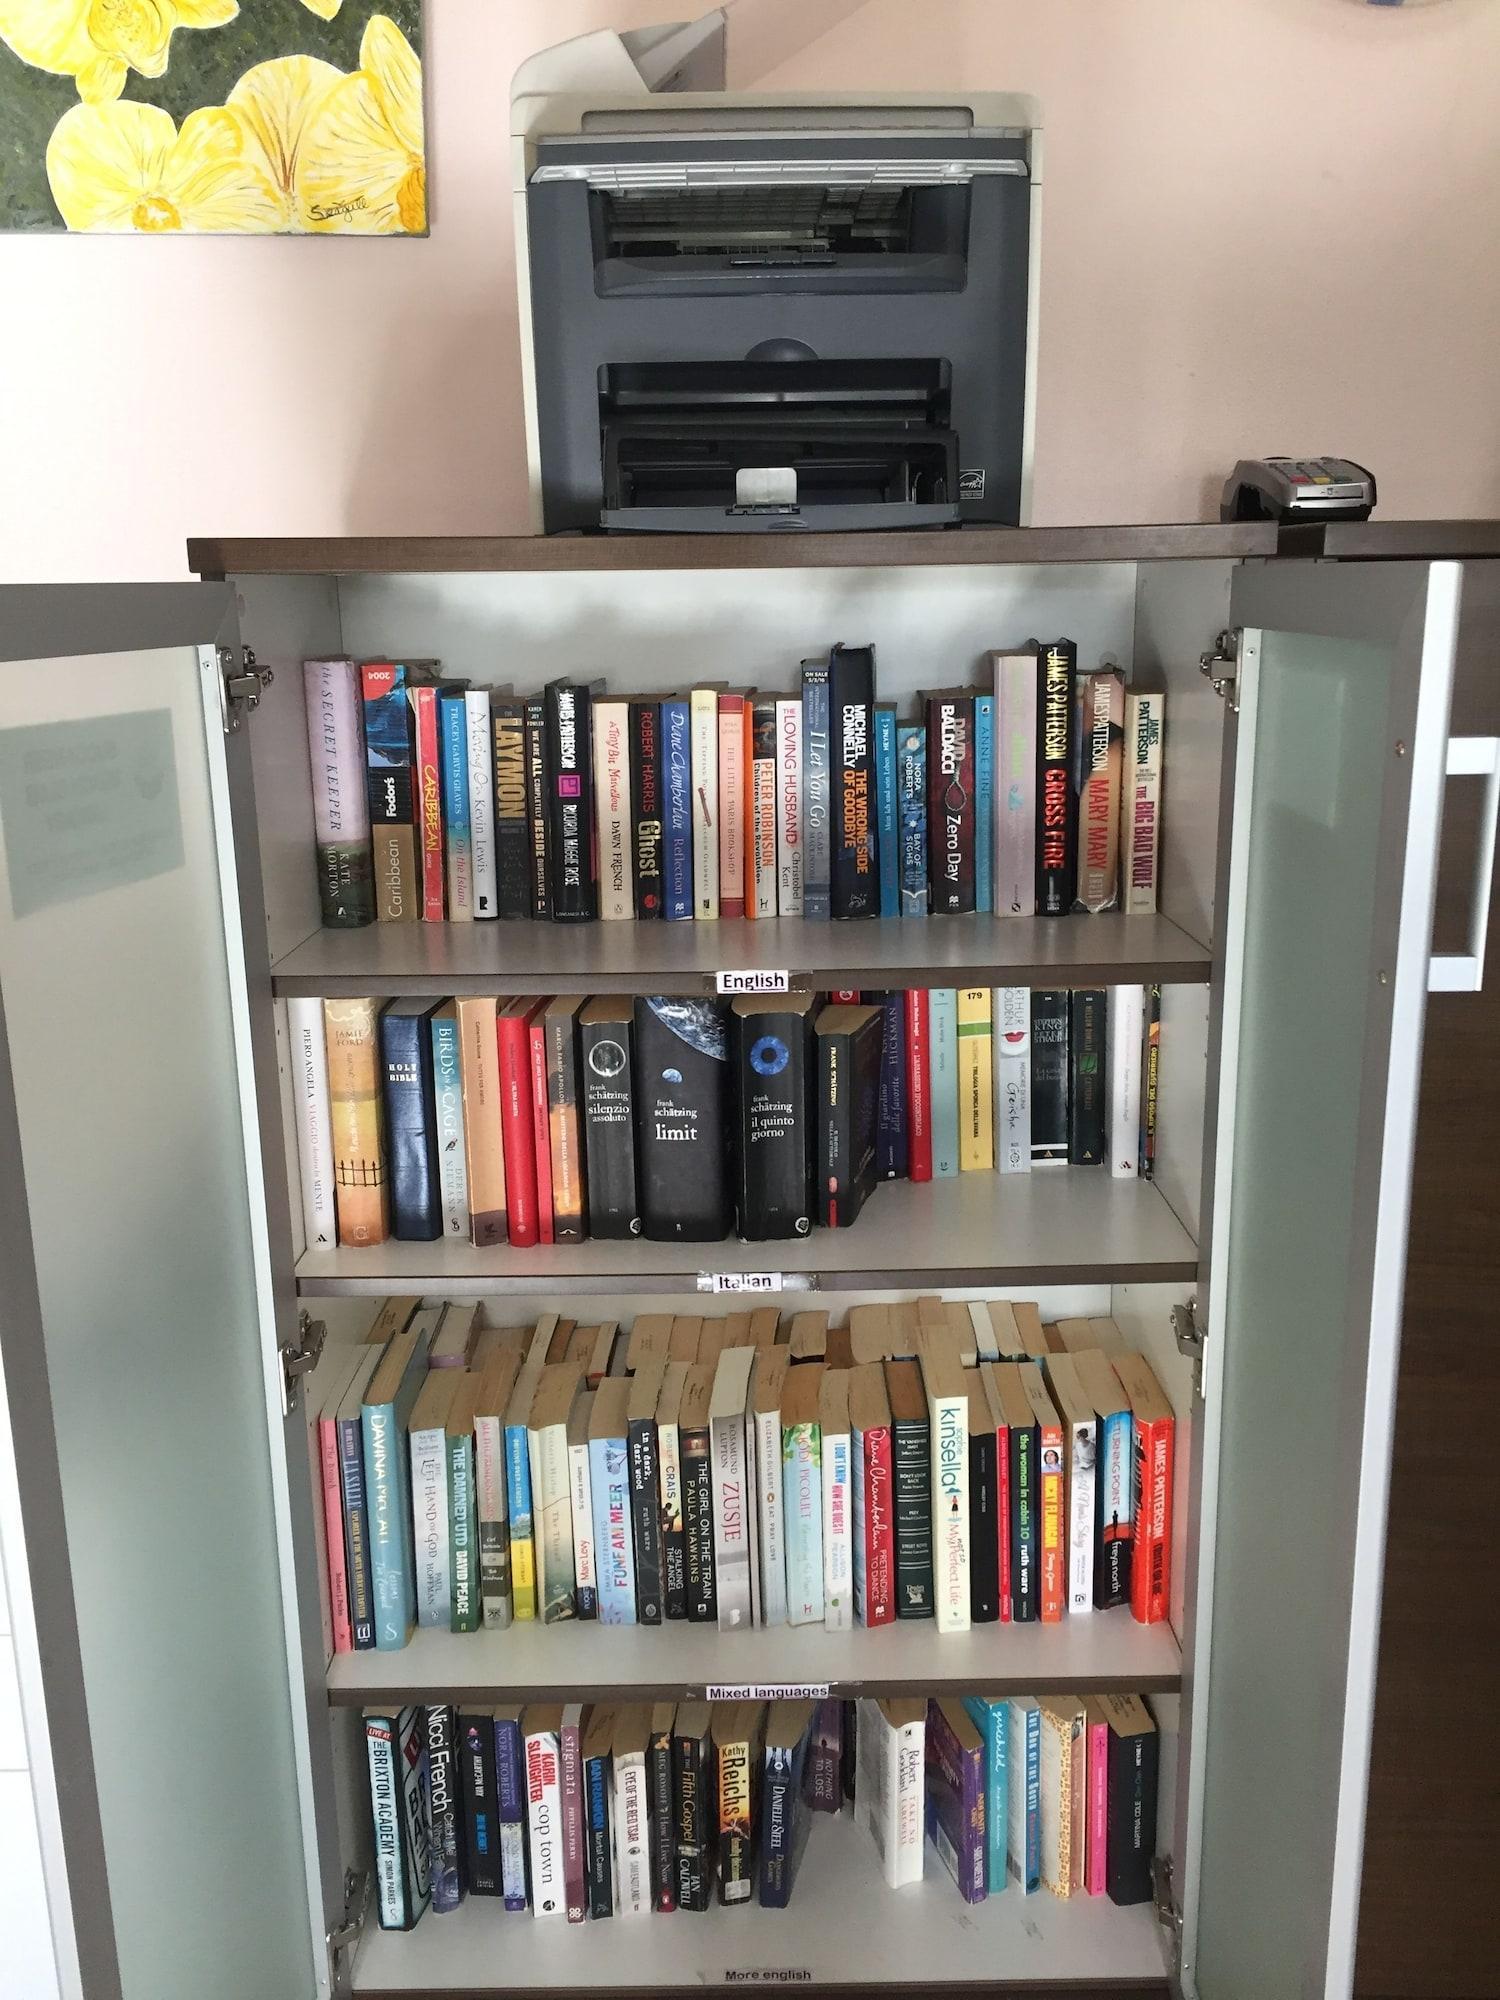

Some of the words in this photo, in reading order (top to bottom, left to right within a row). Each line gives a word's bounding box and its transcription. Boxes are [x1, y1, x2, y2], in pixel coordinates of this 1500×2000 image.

[322, 667, 331, 686] the
[1047, 651, 1068, 691] JAMES
[322, 690, 337, 758] SECRET
[641, 712, 653, 760] ROBERT
[670, 711, 684, 755] Diane
[843, 705, 854, 767] CONNELLY
[854, 705, 865, 759] MICHAEL
[941, 705, 954, 774] BALDACCI
[953, 718, 966, 761] DAVID
[1046, 694, 1066, 760] PATTERSON
[1138, 701, 1150, 764] PATTERSON
[1149, 719, 1158, 745] JAMES
[785, 716, 796, 769] LOVING
[811, 743, 825, 765] Let
[495, 717, 525, 817] LAYMON
[761, 762, 773, 799] PETER
[844, 771, 854, 786] OF
[856, 769, 865, 794] THE
[326, 764, 341, 830] KEEPER
[642, 764, 654, 812] HARRIS
[671, 756, 687, 831] Chamberlain
[810, 773, 825, 798] You
[1045, 769, 1066, 826] CROSS
[1088, 780, 1109, 821] MARY
[1136, 786, 1146, 799] THE
[423, 765, 440, 851] CARIBBEAN
[475, 800, 485, 833] Kevin
[786, 775, 797, 844] HUSBAND
[809, 805, 825, 827] Go
[844, 788, 856, 848] GOODBYE
[857, 797, 867, 843] WRONG
[1135, 801, 1155, 823] BIG
[612, 821, 621, 848] DAWN
[762, 804, 773, 866] ROBINSON
[947, 815, 961, 849] Zero
[1087, 827, 1109, 869] MARY
[1133, 826, 1152, 853] BAD
[477, 840, 487, 873] Lewis
[638, 820, 661, 878] Ghost
[857, 846, 867, 873] SIDE
[914, 854, 921, 866] OF
[1044, 831, 1065, 869] FIRE
[327, 845, 339, 897] MORTON
[340, 853, 351, 885] KATE
[386, 838, 403, 918] Caribbean
[613, 853, 622, 891] FRENCH
[673, 839, 684, 894] Reflection
[782, 867, 791, 887] Kent
[791, 852, 801, 900] Christobel
[946, 853, 960, 881] Day
[1133, 856, 1152, 888] WOLF
[723, 972, 784, 990] English
[303, 1029, 313, 1058] PIERO
[439, 1028, 454, 1074] BIRDS
[306, 1060, 315, 1098] ANGELA
[588, 1104, 629, 1114] silenzio
[589, 1091, 628, 1101] schätzing
[751, 1103, 792, 1113] schätzing
[443, 1092, 456, 1136] CAGE
[593, 1114, 626, 1122] assoluto
[654, 1108, 697, 1118] schätzing
[751, 1118, 758, 1127] il
[760, 1118, 795, 1129] quinto
[656, 1124, 697, 1140] limit
[751, 1130, 784, 1141] giorno
[720, 1274, 771, 1288] Italian
[869, 1430, 886, 1466] Diane
[941, 1408, 960, 1486] kinsella
[1020, 1434, 1028, 1450] the
[1154, 1440, 1165, 1474] JAMES
[453, 1447, 464, 1471] THE
[699, 1461, 707, 1484] THE
[454, 1472, 466, 1521] DAMNED
[666, 1466, 676, 1498] CRAIS
[1021, 1489, 1028, 1497] in
[609, 1483, 624, 1523] MEER
[687, 1480, 696, 1520] PAULA
[700, 1488, 708, 1514] GIRL
[722, 1481, 741, 1543] ZUSJE
[870, 1468, 887, 1550] Chamberlain
[1021, 1500, 1029, 1525] cabin
[1154, 1478, 1165, 1539] PATTERSON
[456, 1523, 467, 1545] UTD
[611, 1528, 625, 1549] AM
[700, 1519, 710, 1535] ON
[1021, 1527, 1029, 1539] 10
[456, 1551, 467, 1580] DAVID
[690, 1528, 699, 1583] HAWKINS
[701, 1540, 710, 1561] THE
[872, 1556, 879, 1567] TO
[612, 1552, 627, 1587] FÜNF
[668, 1566, 676, 1592] ANGEL
[703, 1566, 711, 1599] TRAIN
[879, 1550, 887, 1603] PRETENDING
[457, 1583, 468, 1614] PEACE
[710, 1688, 750, 1698] Mixed
[755, 1688, 827, 1700] languages
[427, 1705, 448, 1749] Nicci
[373, 1741, 387, 1749] THE
[723, 1746, 746, 1757] Kathy
[373, 1750, 391, 1799] BRIXTON
[527, 1741, 542, 1803] SLAUGHTER
[542, 1753, 555, 1785] KARIN
[564, 1735, 576, 1794] stigmata
[625, 1772, 636, 1785] EYE
[816, 1760, 823, 1771] TO
[825, 1759, 833, 1800] NOTHING
[430, 1750, 452, 1813] French
[626, 1785, 636, 1794] OF
[682, 1771, 695, 1797] Fifth
[723, 1758, 746, 1816] Reichs
[815, 1774, 823, 1796] LOSE
[626, 1795, 637, 1809] THE
[627, 1810, 637, 1824] RED
[378, 1803, 393, 1855] ACADEMY
[535, 1805, 551, 1835] cop
[568, 1807, 576, 1837] PHYLLIS
[627, 1825, 637, 1842] TSAR
[680, 1800, 695, 1842] Gospel
[595, 1832, 603, 1854] Mortal
[384, 1860, 393, 1880] SIMON
[540, 1841, 554, 1883] town
[596, 1857, 604, 1883] Causes
[387, 1882, 396, 1904] PARKES
[680, 1859, 690, 1904] CALDWELL
[691, 1875, 700, 1892] IAN
[725, 1970, 759, 1980] More
[763, 1970, 811, 1981] english
